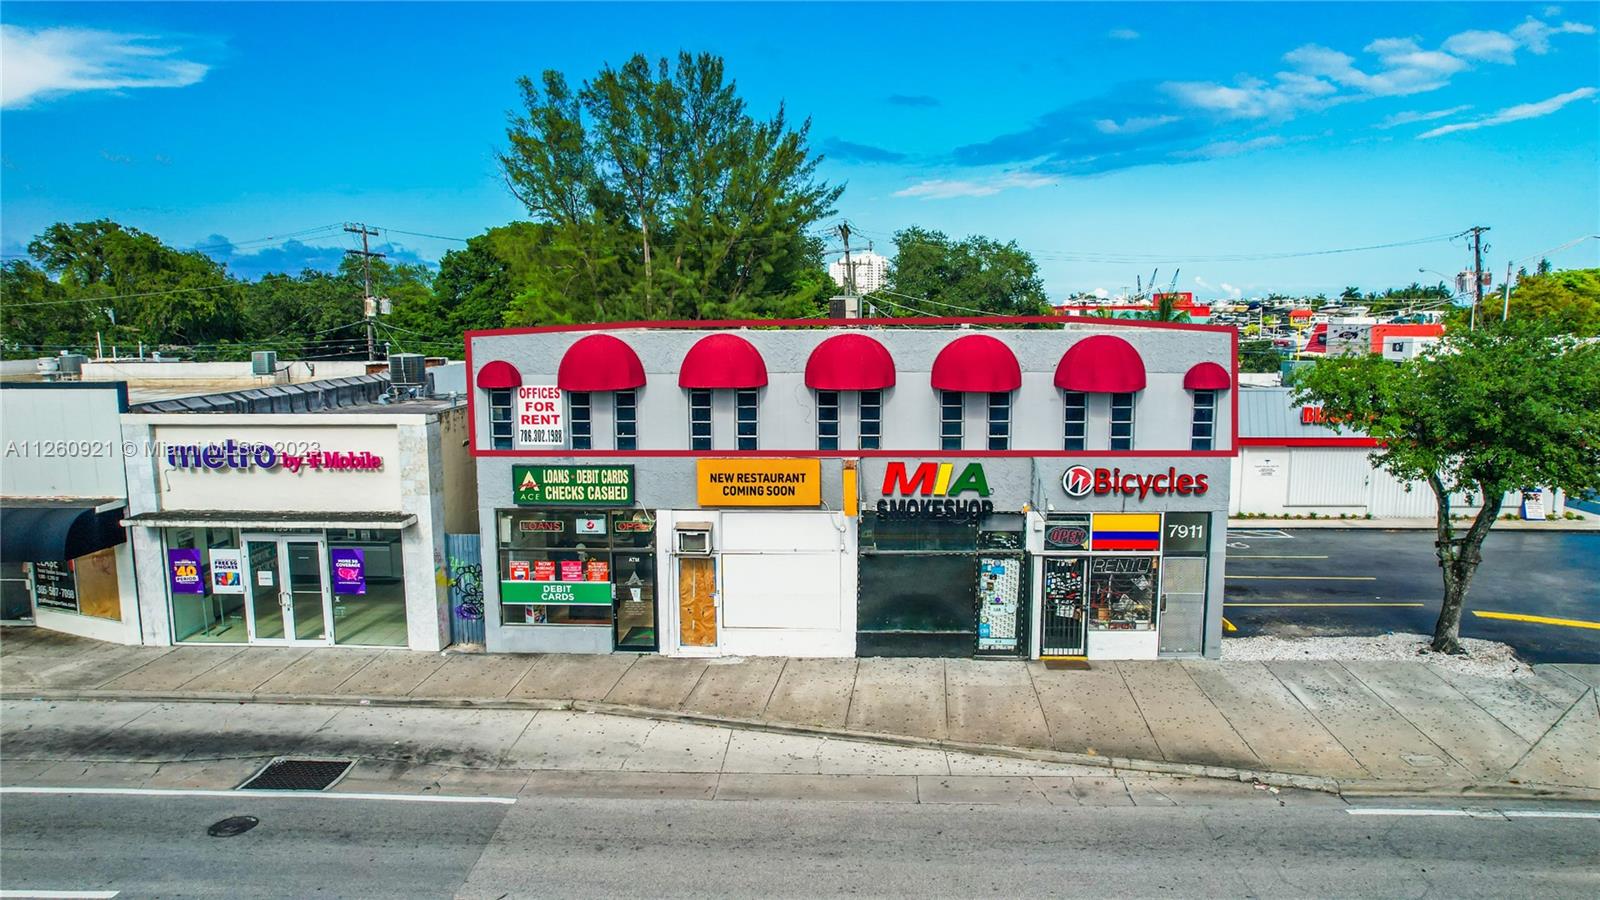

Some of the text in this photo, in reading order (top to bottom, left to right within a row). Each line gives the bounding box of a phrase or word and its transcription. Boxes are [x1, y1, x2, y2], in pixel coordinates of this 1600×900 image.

[520, 387, 560, 399] OFFICES
[525, 402, 554, 411] FOR
[521, 415, 560, 425] RENT
[168, 439, 277, 469] metro
[282, 452, 301, 472] by
[324, 451, 382, 468] Mobile
[543, 469, 629, 484] LOANS DEBIT CARDS
[710, 473, 807, 483] NEW RESTAURANT
[882, 462, 990, 497] MIA
[1094, 467, 1209, 499] Bicycles
[545, 485, 628, 501] CHECKS CASHED
[722, 485, 796, 497] COMING SOON
[876, 498, 994, 520] SMOKESHOP
[522, 521, 561, 531] LOANS
[1168, 524, 1204, 539] 7911
[1050, 528, 1086, 546] OPEN
[543, 584, 572, 593] DEBIT
[541, 593, 575, 601] CARDS
